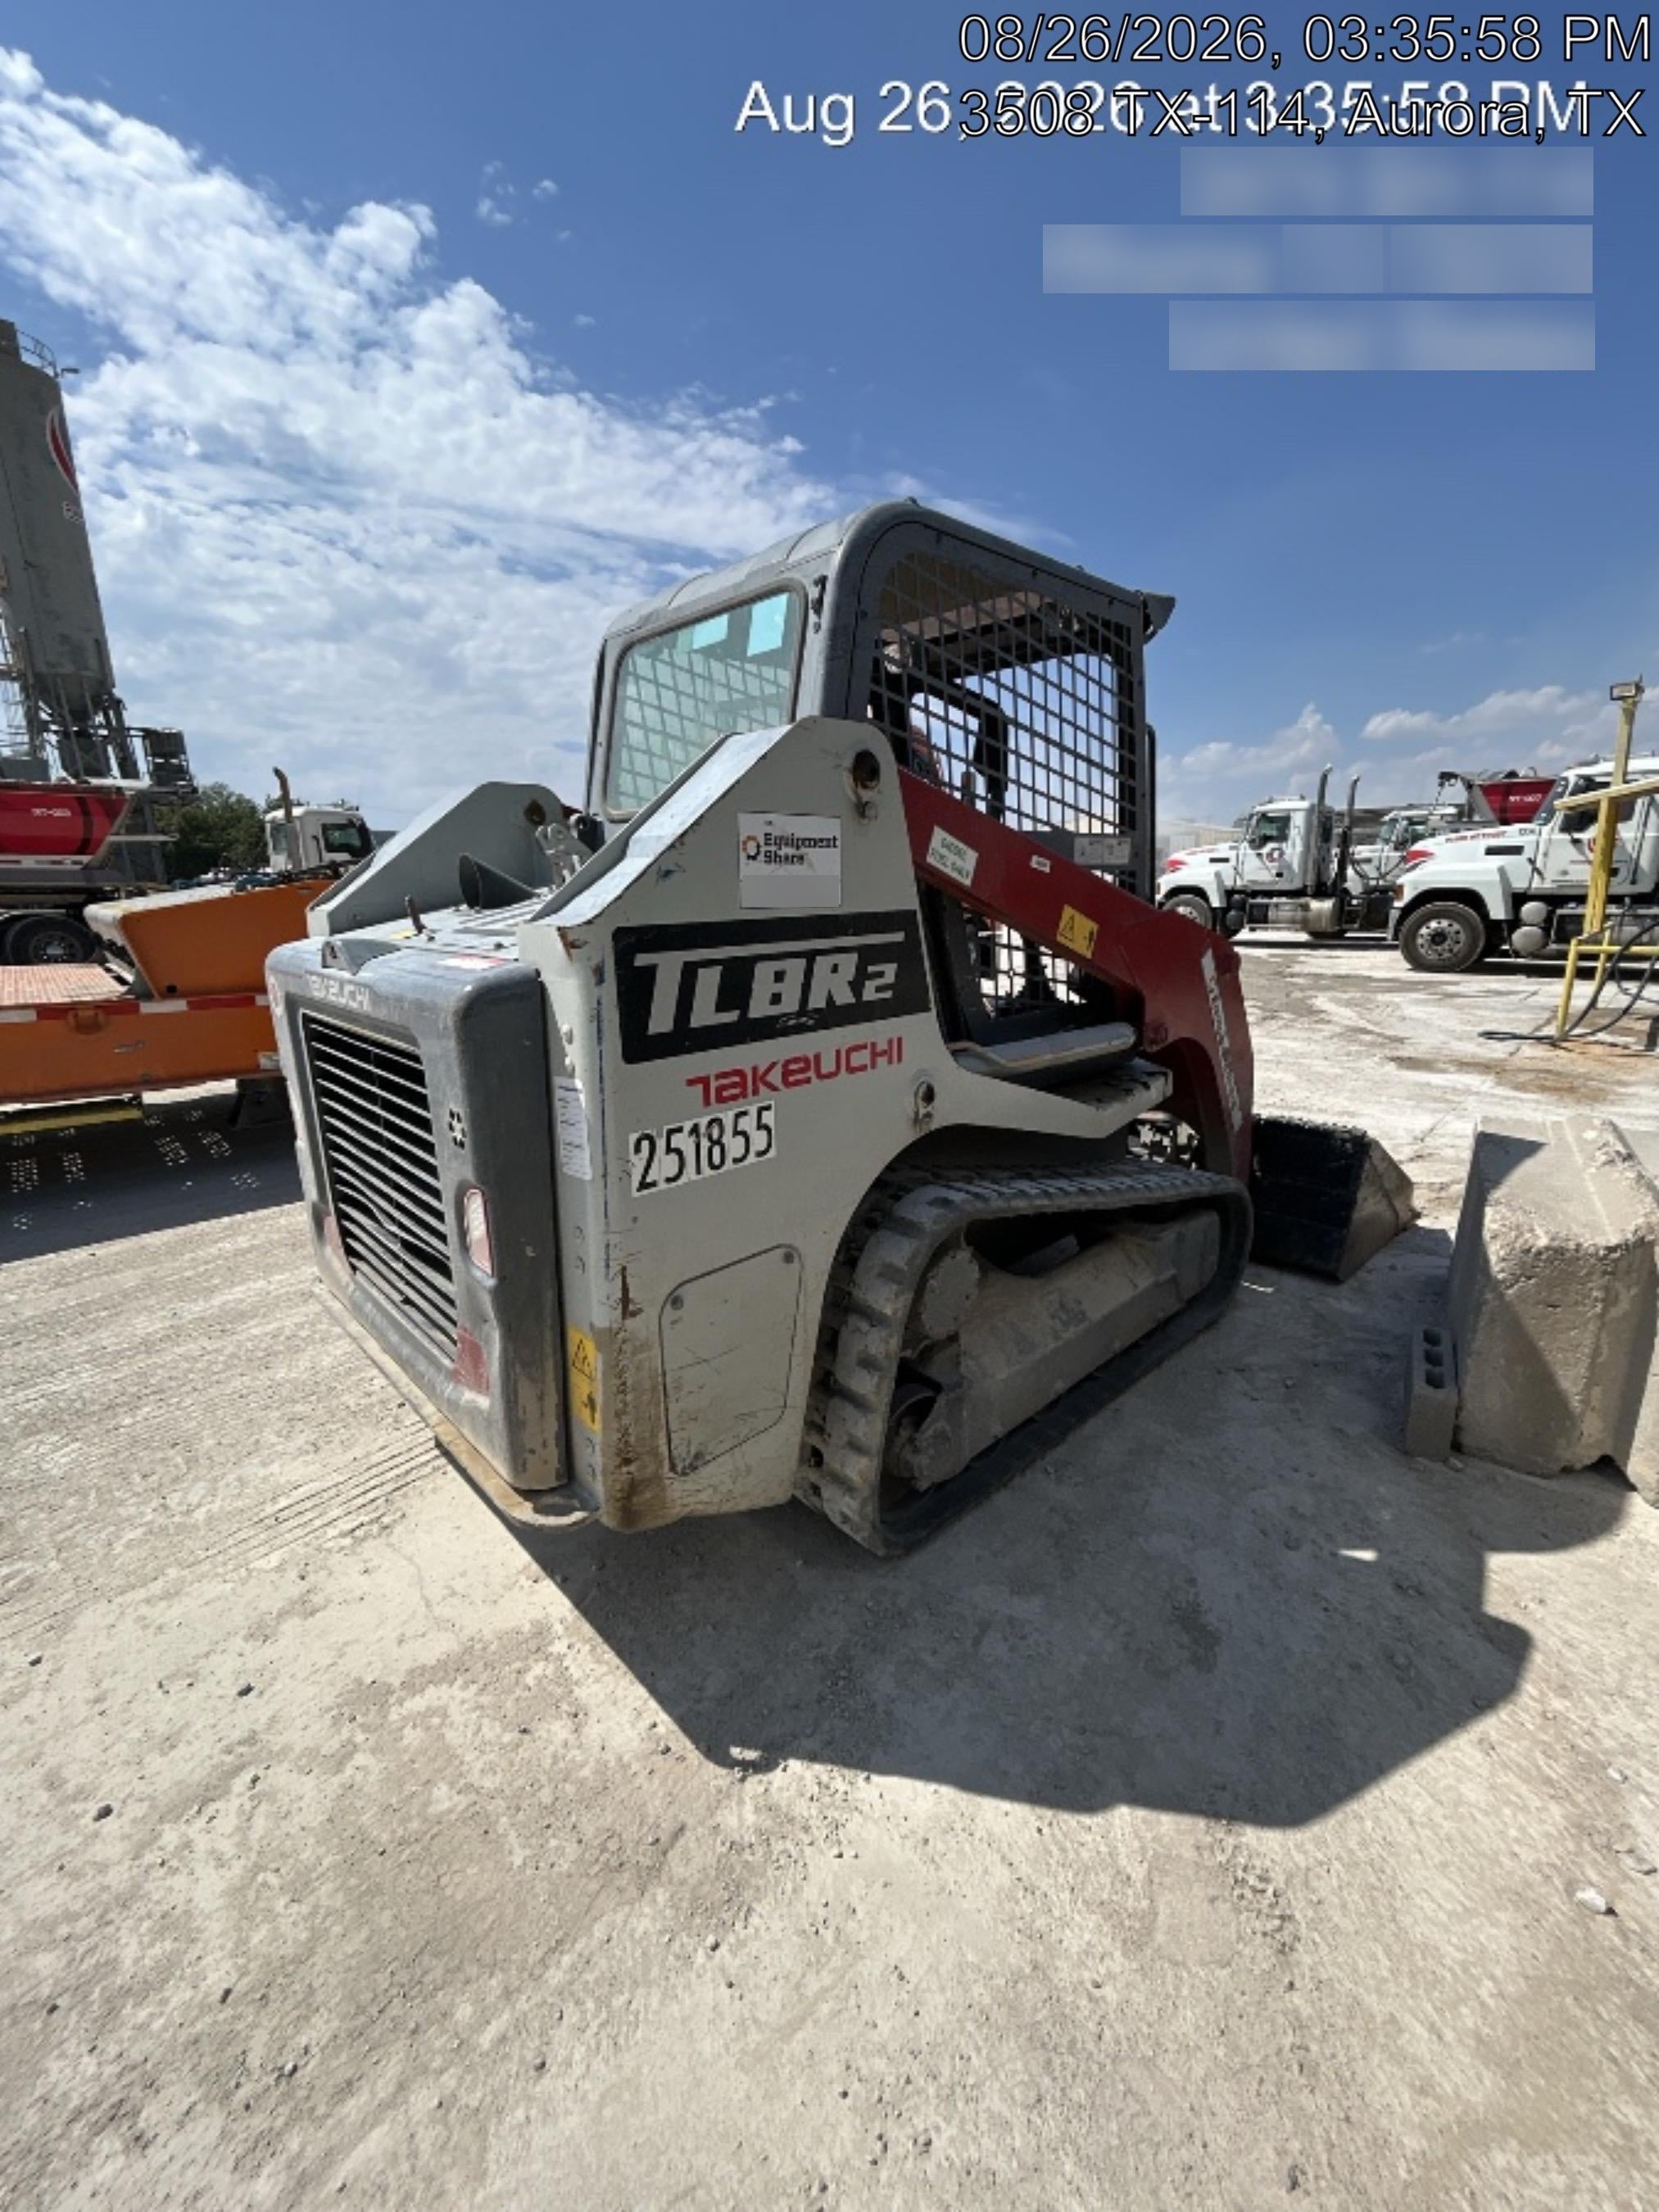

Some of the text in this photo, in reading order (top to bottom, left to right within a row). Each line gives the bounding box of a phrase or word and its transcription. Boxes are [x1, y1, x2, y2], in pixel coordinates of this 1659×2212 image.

[764, 832, 839, 850] Equipment
[764, 850, 805, 865] Share
[633, 1104, 774, 1194] 251855
